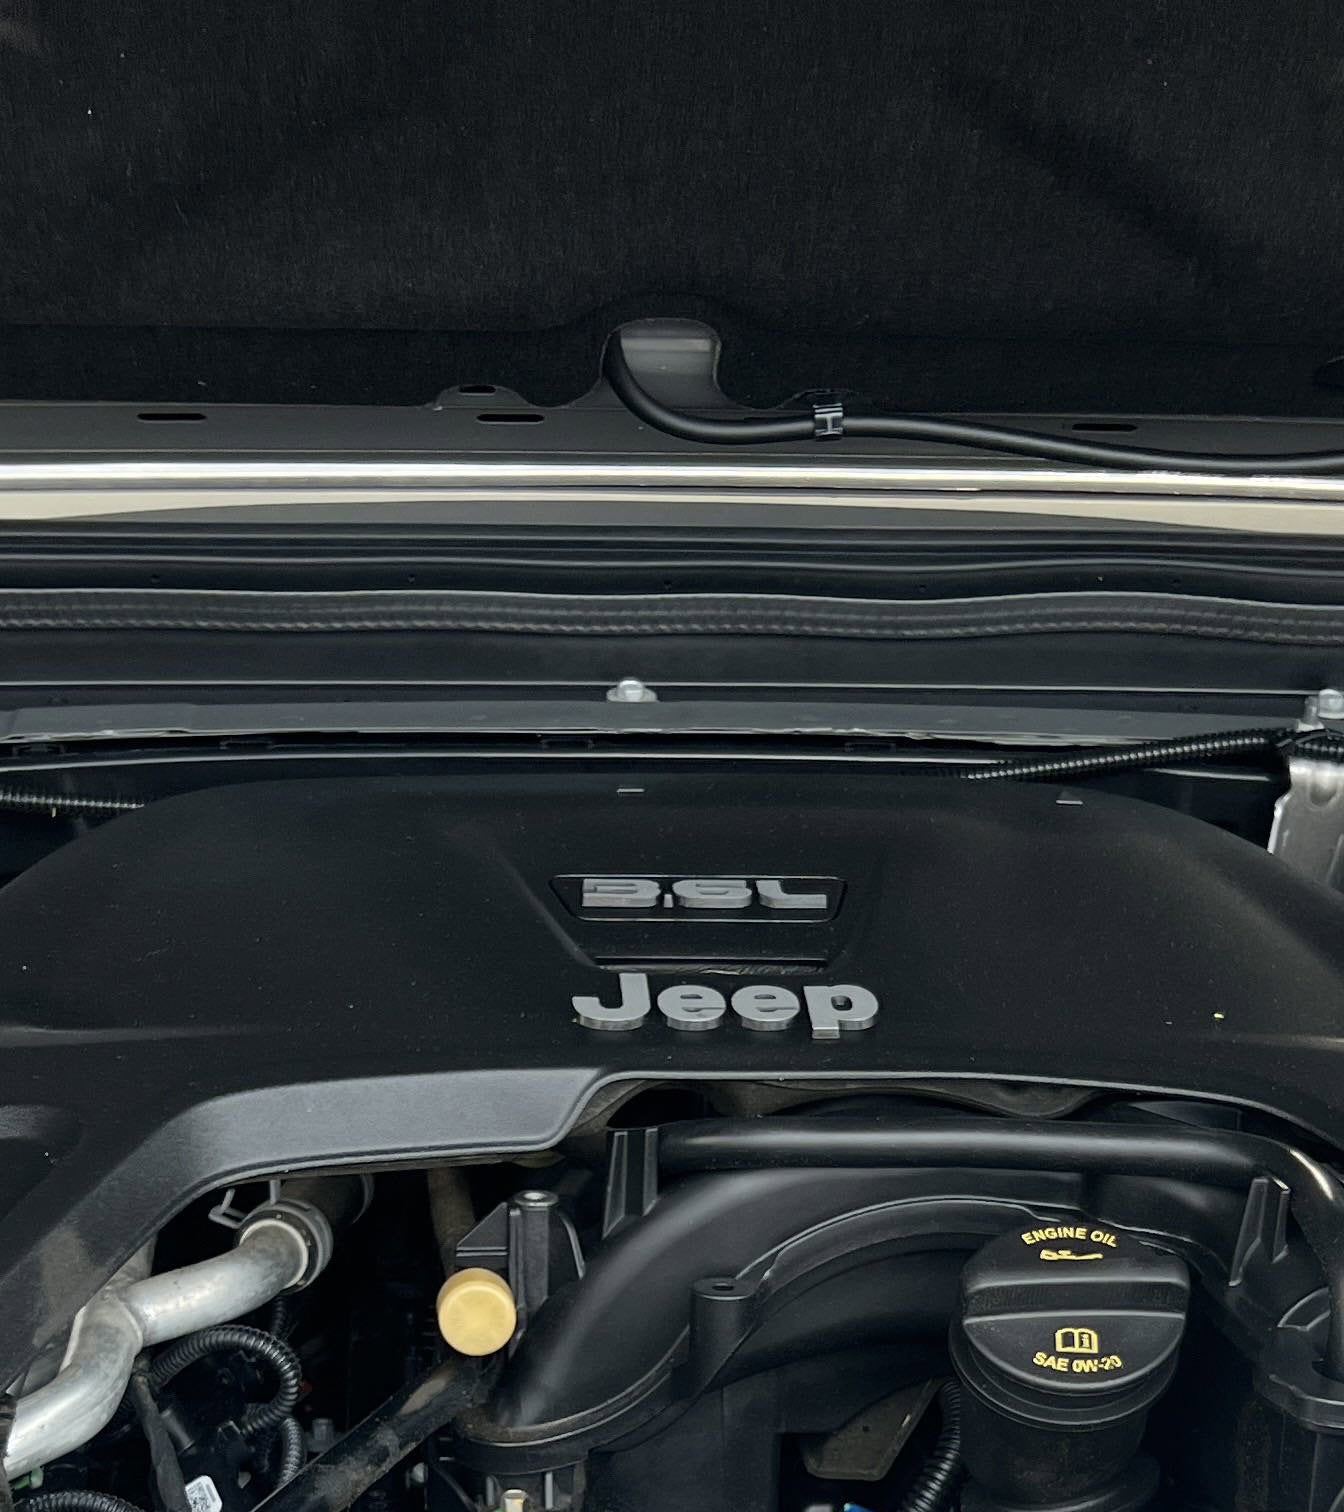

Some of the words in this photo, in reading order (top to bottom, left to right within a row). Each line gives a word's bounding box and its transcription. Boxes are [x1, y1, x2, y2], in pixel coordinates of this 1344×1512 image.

[571, 973, 880, 1040] Jeep
[1020, 1226, 1088, 1248] ENGINE
[1089, 1230, 1118, 1248] OIL
[1032, 1351, 1069, 1373] SAE
[1071, 1354, 1122, 1374] 0W-20
